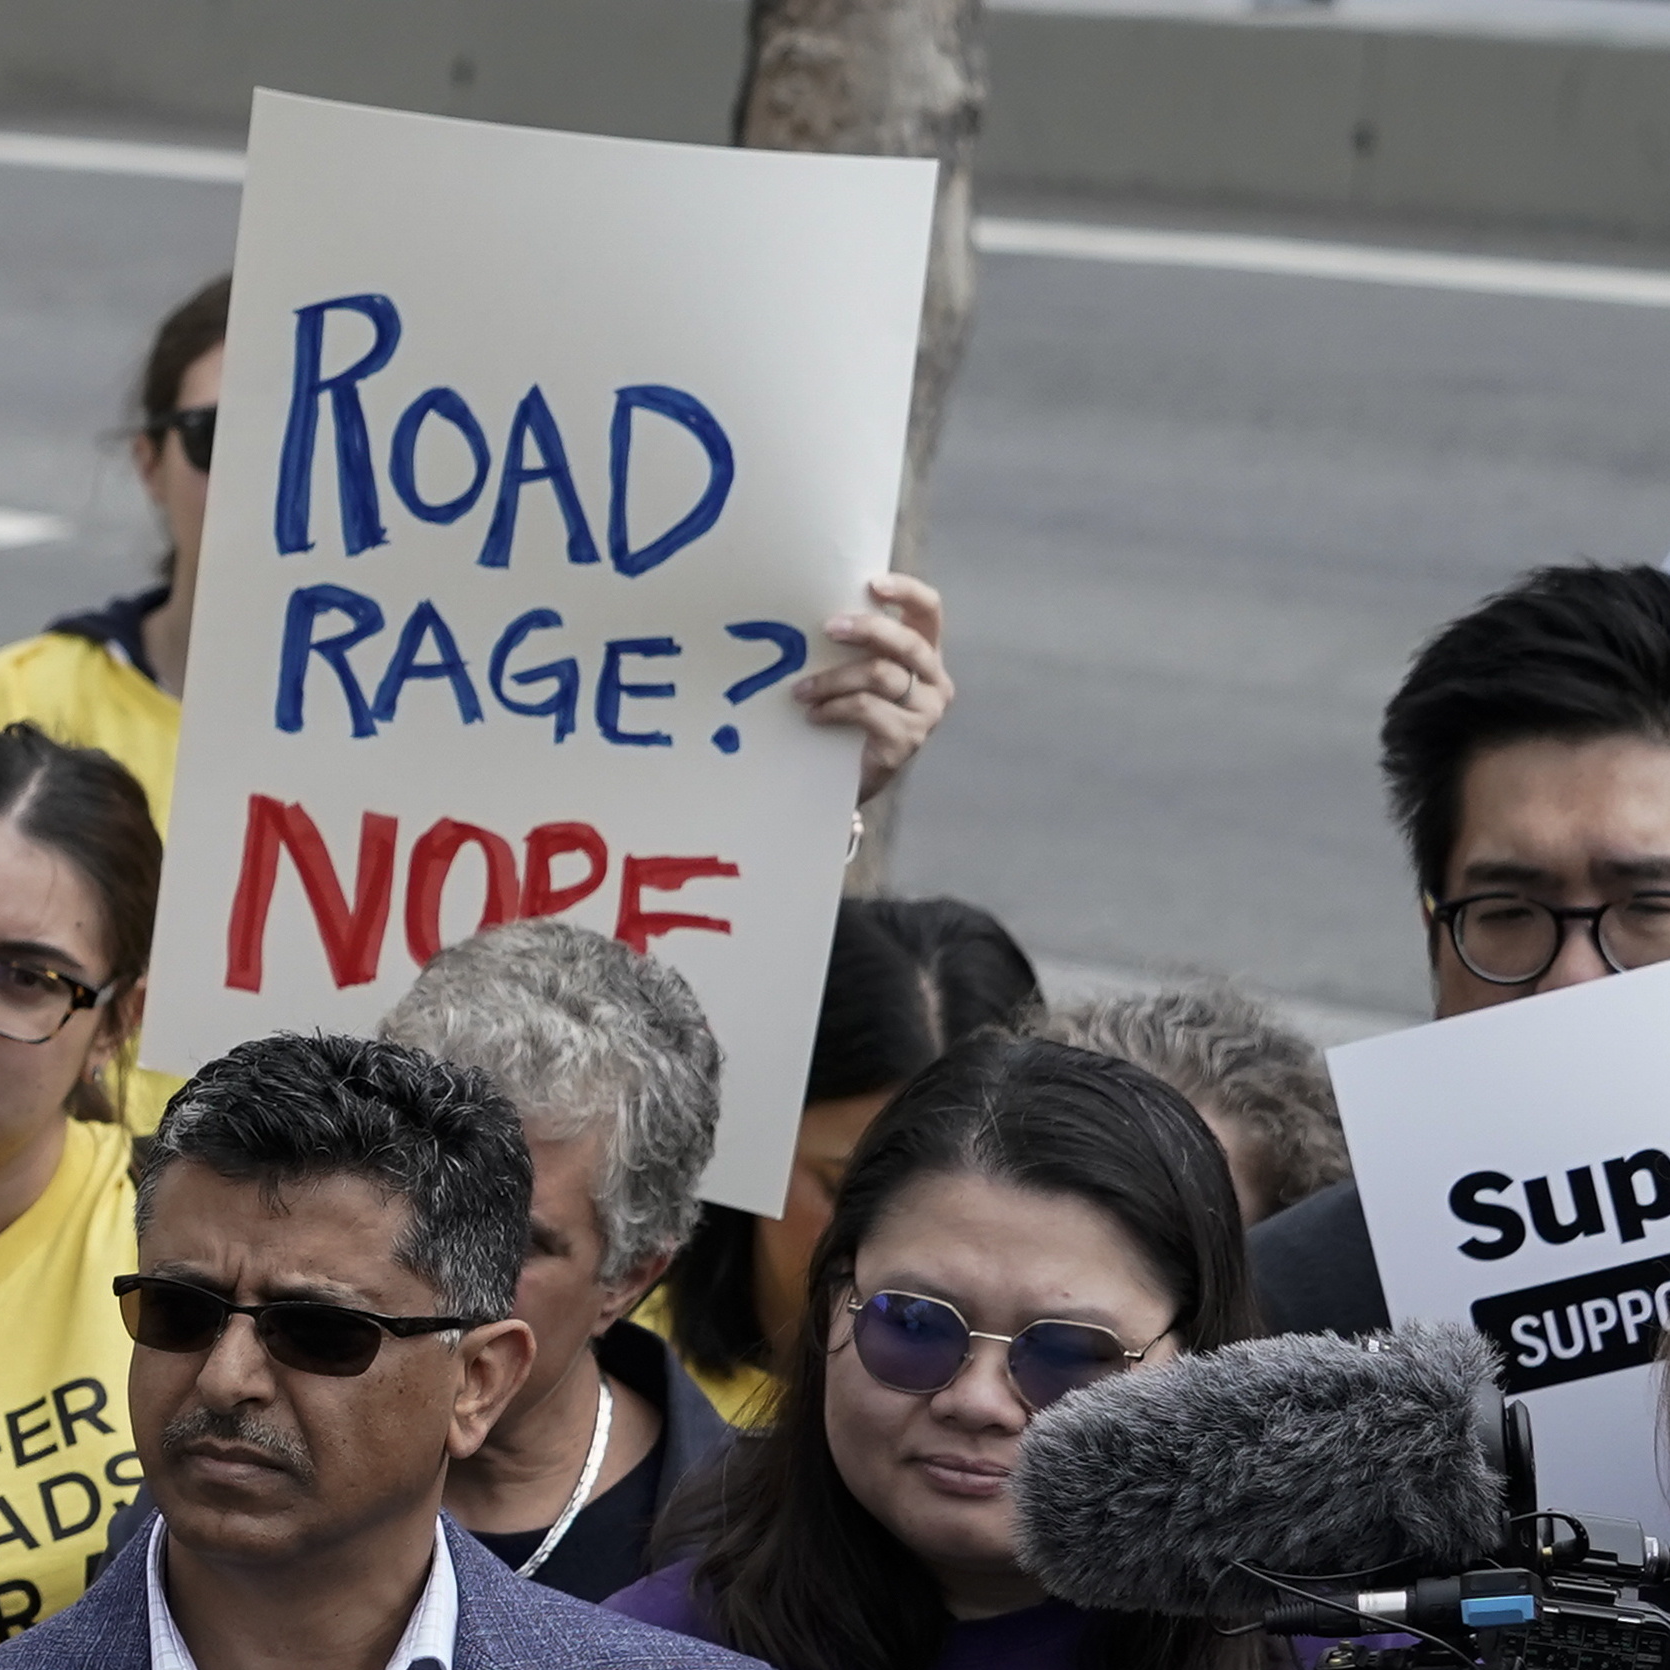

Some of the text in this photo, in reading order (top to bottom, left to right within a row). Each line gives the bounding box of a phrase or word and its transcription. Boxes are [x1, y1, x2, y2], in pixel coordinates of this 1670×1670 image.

[274, 294, 735, 578] ROAD
[275, 583, 807, 755] RAGE?
[225, 795, 740, 992] NOPE
